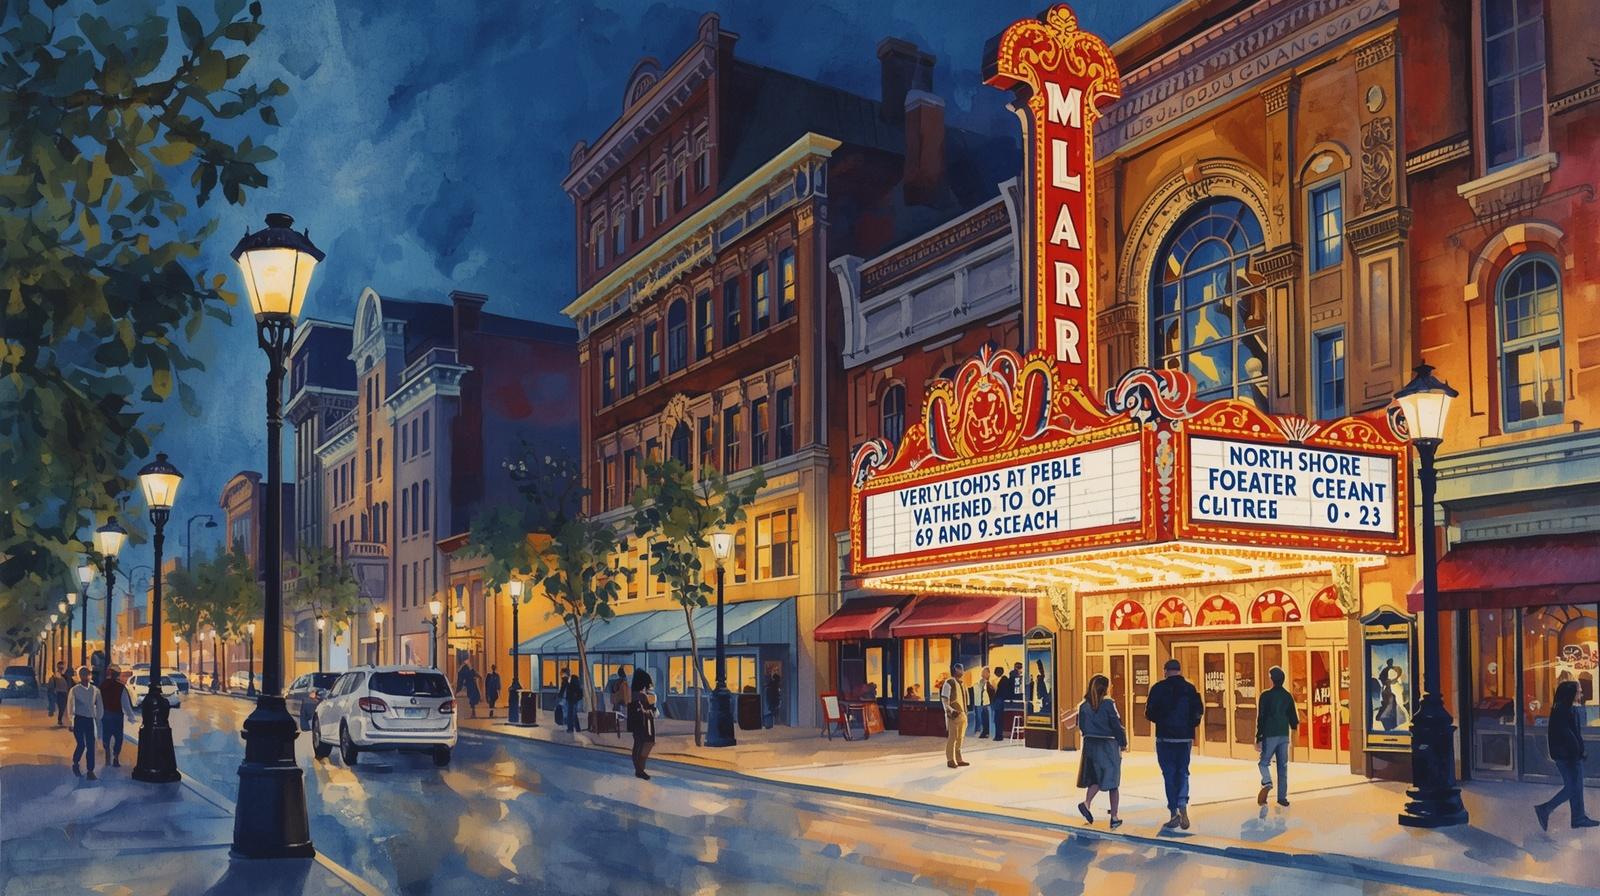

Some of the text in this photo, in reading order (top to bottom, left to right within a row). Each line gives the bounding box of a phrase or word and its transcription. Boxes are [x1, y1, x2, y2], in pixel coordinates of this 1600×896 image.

[1044, 81, 1083, 364] MLARR
[1007, 468, 1027, 489] AT
[1031, 457, 1082, 485] PEBLE
[1230, 446, 1361, 477] NORTH SHORE
[1208, 468, 1387, 503] FOEATER CEEANT
[913, 485, 1056, 526] VATHENED TO OF
[915, 527, 933, 547] 69
[938, 524, 972, 544] AND
